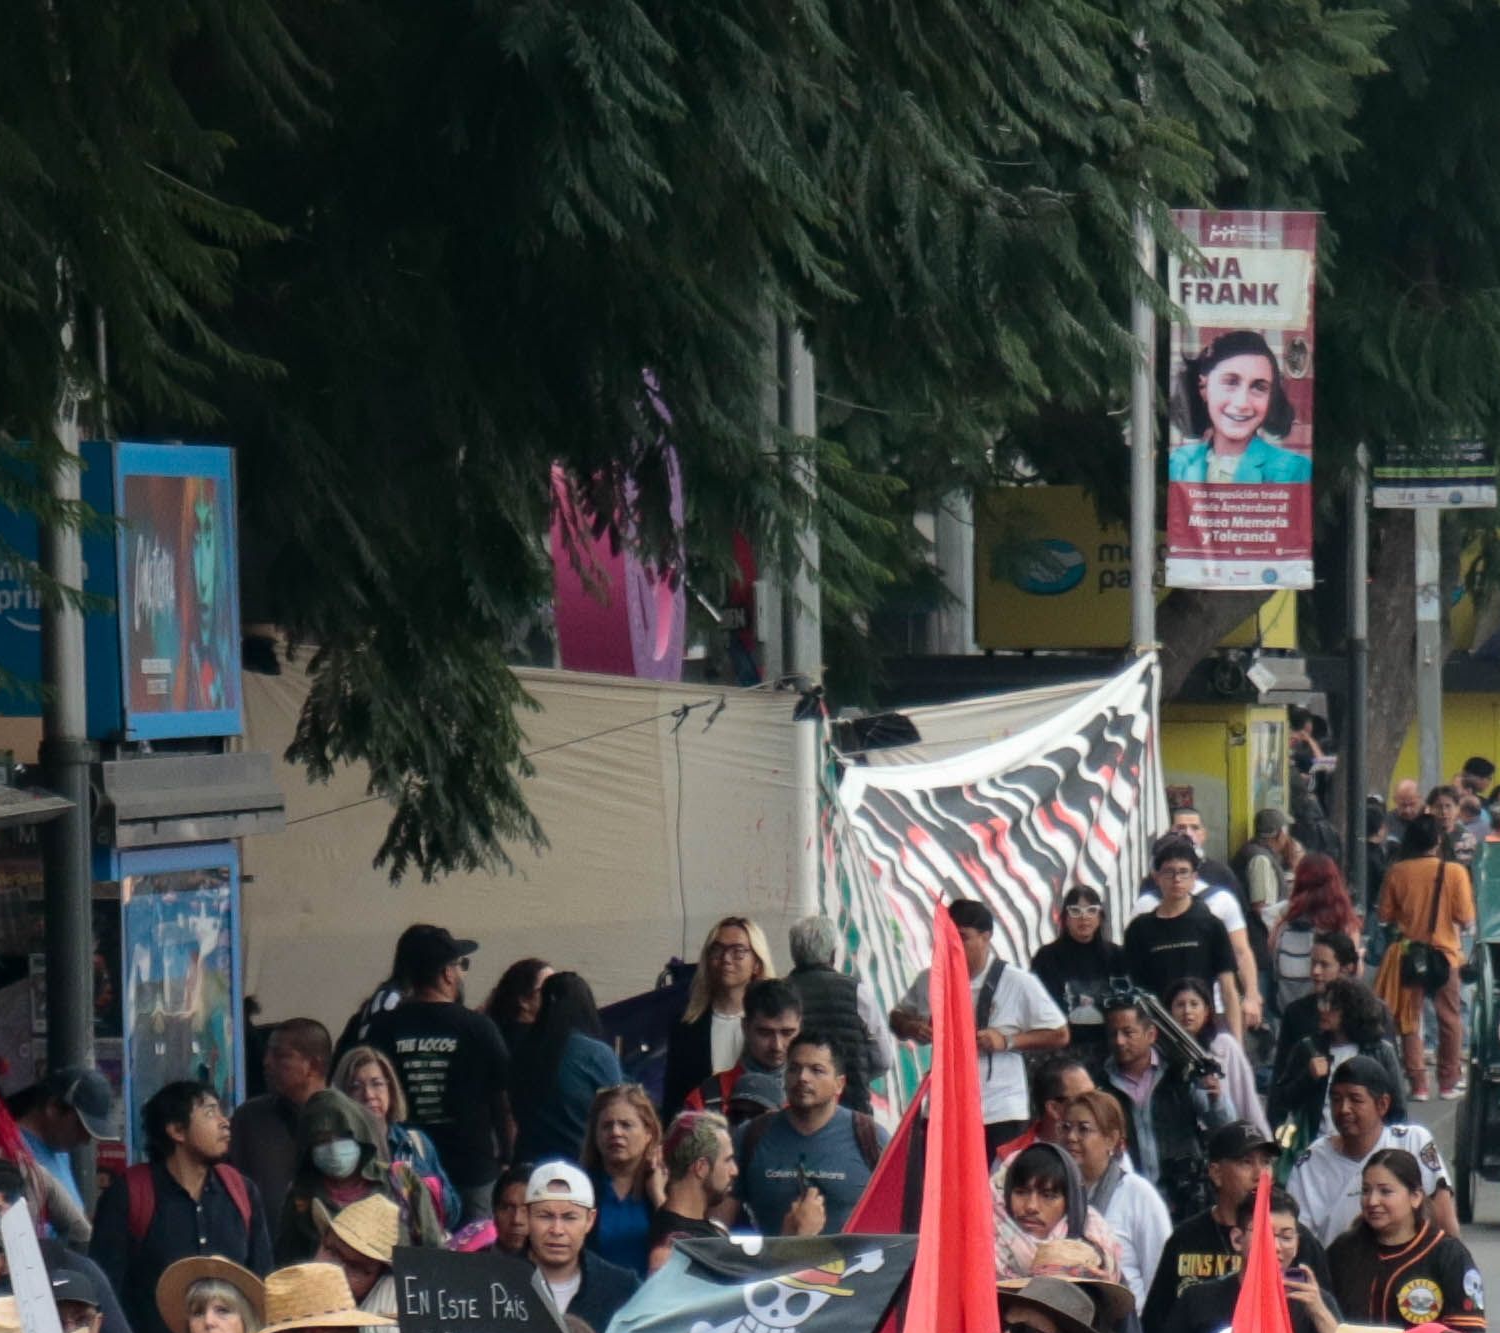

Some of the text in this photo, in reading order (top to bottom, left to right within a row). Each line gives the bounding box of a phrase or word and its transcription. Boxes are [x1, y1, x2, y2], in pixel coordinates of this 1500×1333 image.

[1180, 257, 1242, 279] ANA
[1180, 282, 1280, 306] FRANK
[1188, 516, 1289, 529] Museo Memoria
[1212, 530, 1277, 543] Tolerancia
[417, 1037, 457, 1052] LOCOS
[1177, 1254, 1214, 1277] GUNS
[437, 1294, 480, 1323] ESTE
